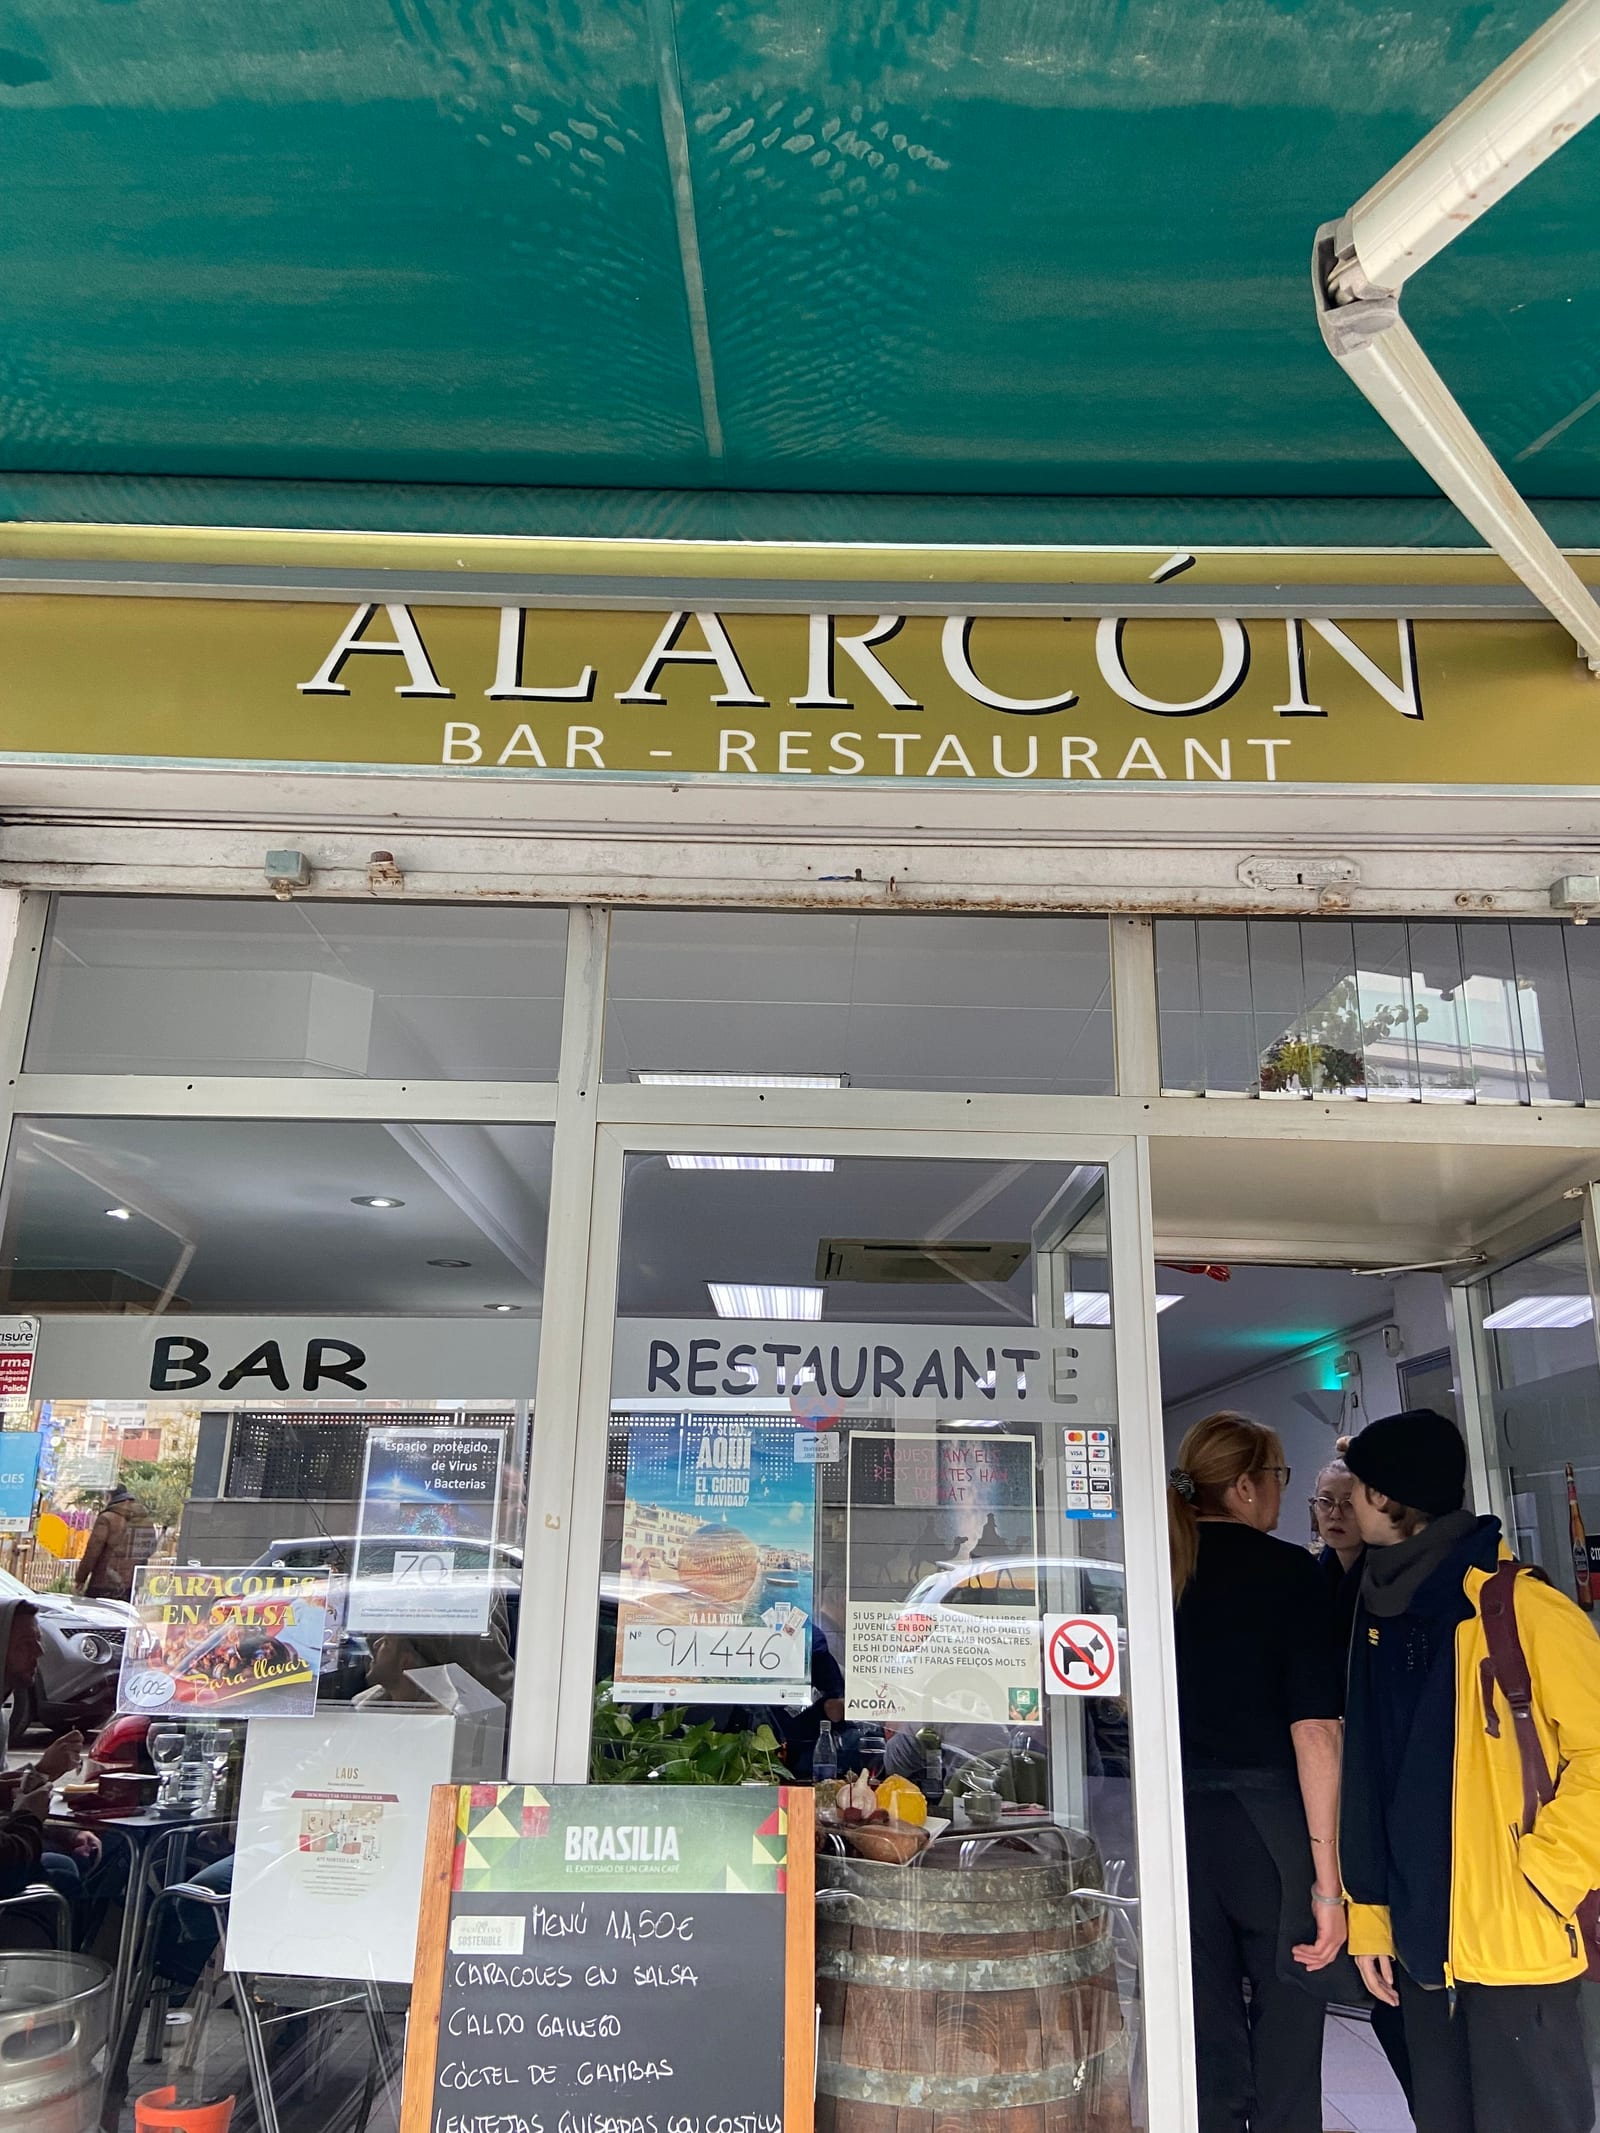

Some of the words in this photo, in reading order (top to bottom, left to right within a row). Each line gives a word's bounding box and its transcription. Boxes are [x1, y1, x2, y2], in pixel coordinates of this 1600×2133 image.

[296, 553, 1424, 720] ALARCÓN
[441, 720, 606, 769] BAR
[649, 749, 672, 758] -
[717, 729, 1292, 781] RESTAURANT
[148, 1336, 368, 1392] BAR
[647, 1338, 1080, 1404] RESTAURANTE
[385, 1441, 427, 1453] Espacio
[432, 1441, 488, 1454] protegido
[884, 1447, 936, 1461] AQUEST
[943, 1448, 970, 1463] ANY
[974, 1449, 1001, 1463] ELS
[431, 1461, 446, 1471] de
[449, 1461, 478, 1472] Virus
[915, 1467, 974, 1482] PIRATES
[424, 1480, 431, 1491] y
[434, 1479, 486, 1490] Bacterias
[695, 1476, 708, 1493] EL
[711, 1477, 750, 1494] GORDO
[694, 1494, 706, 1507] DE
[707, 1494, 749, 1508] NAVIDAD?
[150, 1576, 316, 1597] CARACOLES
[162, 1604, 201, 1625] EN
[209, 1605, 297, 1626] SALSA
[689, 1613, 697, 1624] YA
[700, 1613, 706, 1624] A
[707, 1613, 717, 1624] LA
[719, 1613, 743, 1625] VENTA
[853, 1612, 861, 1620] SI
[863, 1612, 875, 1620] US
[905, 1613, 913, 1621] SI
[915, 1613, 937, 1622] TENS
[853, 1622, 896, 1631] JUVENILS
[912, 1624, 932, 1632] BON
[934, 1625, 965, 1634] ESTAT,
[982, 1626, 996, 1634] HO
[853, 1633, 856, 1641] I
[858, 1633, 888, 1641] POSAT
[890, 1634, 902, 1642] EN
[904, 1634, 952, 1643] CONTACTE
[955, 1635, 976, 1644] AMB
[977, 1636, 1033, 1646] NOSALTRES.
[656, 1627, 783, 1670] 91.446
[853, 1644, 869, 1652] ELS
[871, 1644, 880, 1652] HI
[882, 1645, 929, 1653] DONAREM
[931, 1645, 951, 1654] UNA
[952, 1646, 990, 1655] SEGONA
[852, 1665, 877, 1673] NENS
[884, 1666, 914, 1675] NENES
[925, 1656, 954, 1665] FARAS
[956, 1657, 993, 1668] FELIÇOS
[995, 1658, 1027, 1667] MOLTS
[181, 1674, 247, 1704] Para
[253, 1658, 310, 1680] llevar
[336, 1767, 359, 1779] LAUS
[564, 1825, 680, 1862] BRASILIA
[566, 1864, 573, 1873] EL
[575, 1865, 614, 1873] EXOTISMO
[615, 1865, 625, 1873] DE
[626, 1865, 637, 1873] UN
[638, 1865, 660, 1873] GRAN
[533, 1901, 587, 1937] MENÚ
[455, 1961, 572, 1988] CARACOLES
[585, 1965, 617, 1987] EN
[633, 1963, 698, 1988] SALSA
[448, 2007, 524, 2036] CALDO
[527, 2064, 558, 2086] DE
[577, 2059, 674, 2086] GAMBAS
[435, 2108, 544, 2133] LENTEJAS
[558, 2109, 658, 2133] GUISADAS
